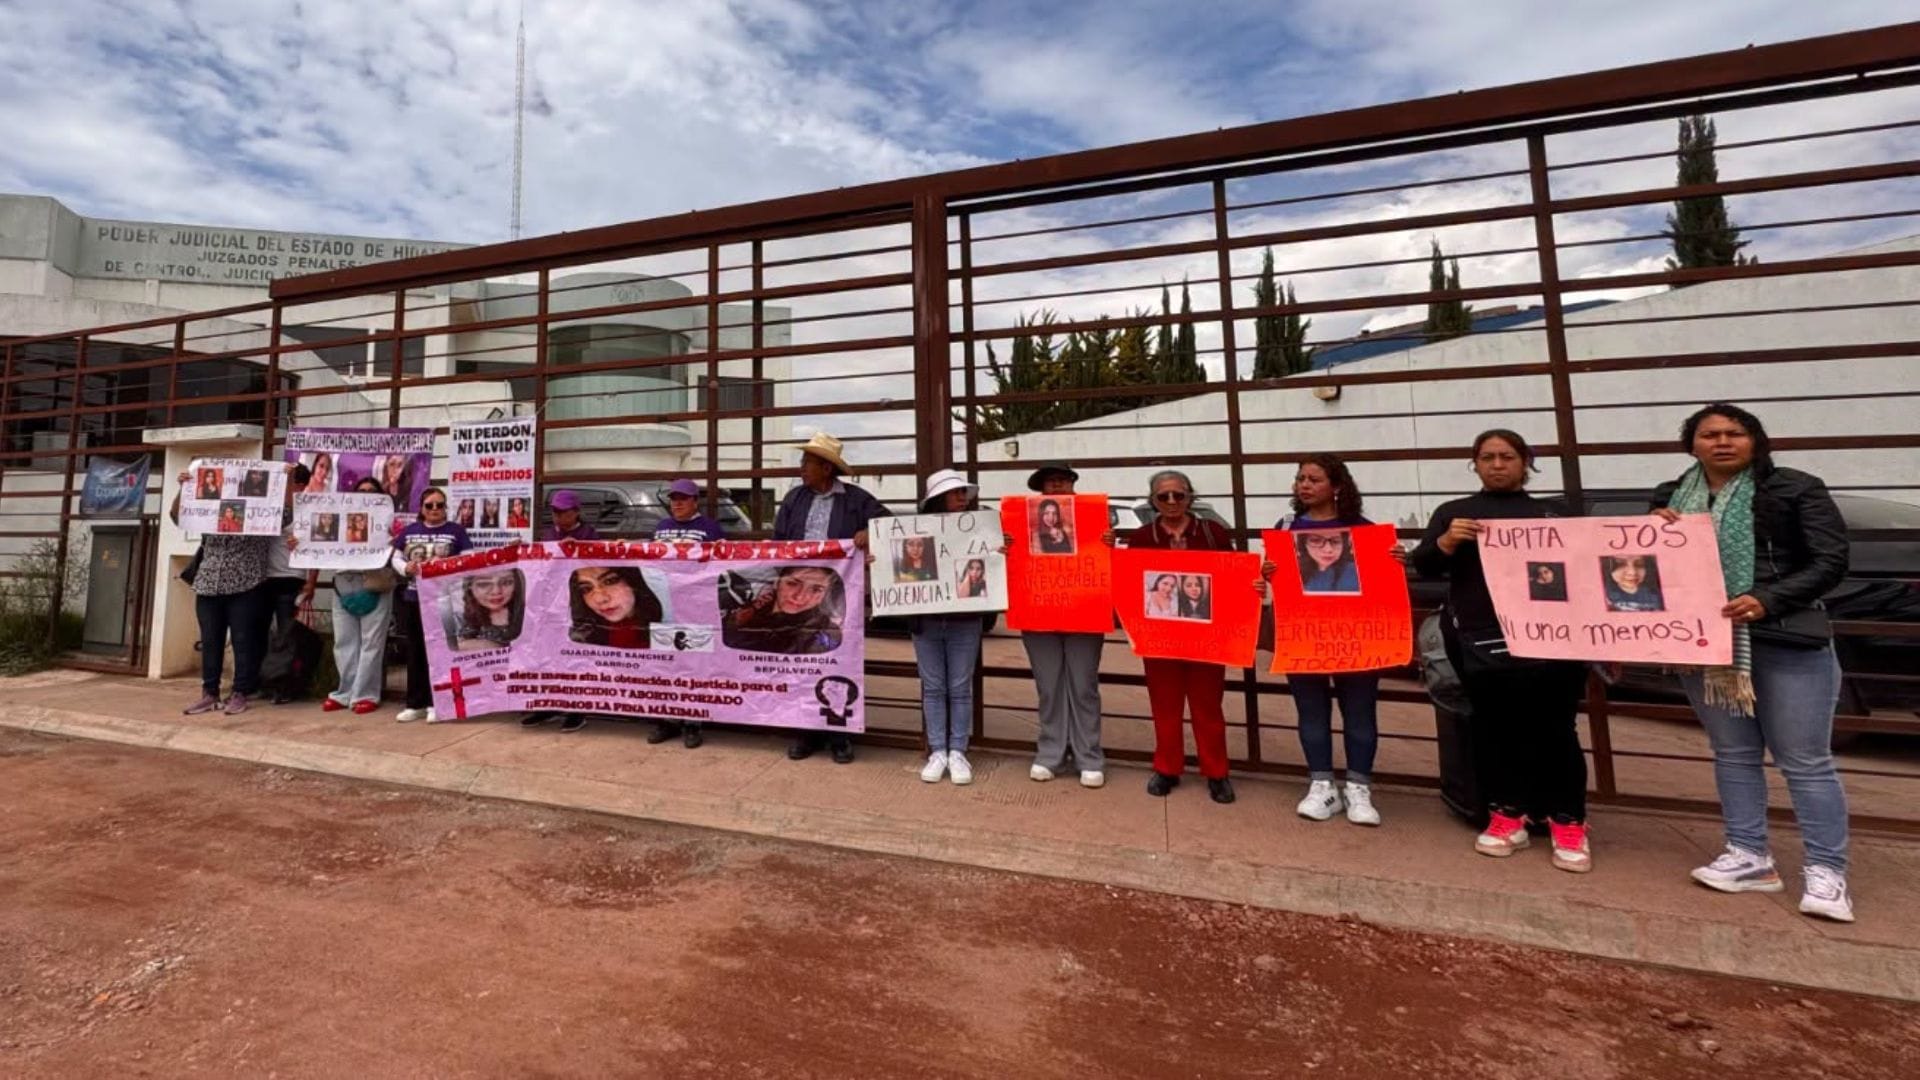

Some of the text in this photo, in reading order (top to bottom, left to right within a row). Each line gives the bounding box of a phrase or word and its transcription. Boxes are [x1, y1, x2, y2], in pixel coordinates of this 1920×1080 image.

[98, 226, 159, 244] PODER
[169, 231, 249, 250] JUDICIAL
[257, 236, 286, 251] DEL
[291, 238, 355, 256] ESTADO
[364, 243, 385, 258] DE
[197, 251, 280, 266] JUZGADOS
[104, 260, 124, 273] DE
[453, 429, 472, 440] ¡NI
[458, 440, 529, 454] NI OLVIDO!
[479, 457, 496, 468] NO
[452, 469, 533, 482] FEMINICIDIOS
[1483, 519, 1687, 549] LUPITA JOS
[940, 540, 990, 558] A LA
[872, 582, 952, 609] VIOLENCIA!
[1278, 619, 1410, 643] IRREVOCABLE
[1525, 622, 1571, 642] una
[1583, 618, 1709, 647] menos!
[561, 649, 622, 658] GUADALUPE
[1315, 640, 1363, 657] PARA
[595, 660, 640, 670] GARRIDO
[739, 654, 790, 663] DANIELA
[541, 672, 577, 680] meses
[579, 672, 598, 681] sin
[601, 673, 611, 683] la
[614, 674, 672, 687] obtención
[674, 678, 688, 688] de
[689, 678, 739, 690] justicia
[741, 682, 773, 693] para
[776, 682, 788, 693] el
[540, 685, 618, 697] FEMINICIDIO
[619, 687, 627, 698] Y
[629, 689, 679, 701] ABORTO
[681, 693, 743, 706] FORZADO
[595, 701, 611, 711] LA
[613, 702, 645, 713] PENA
